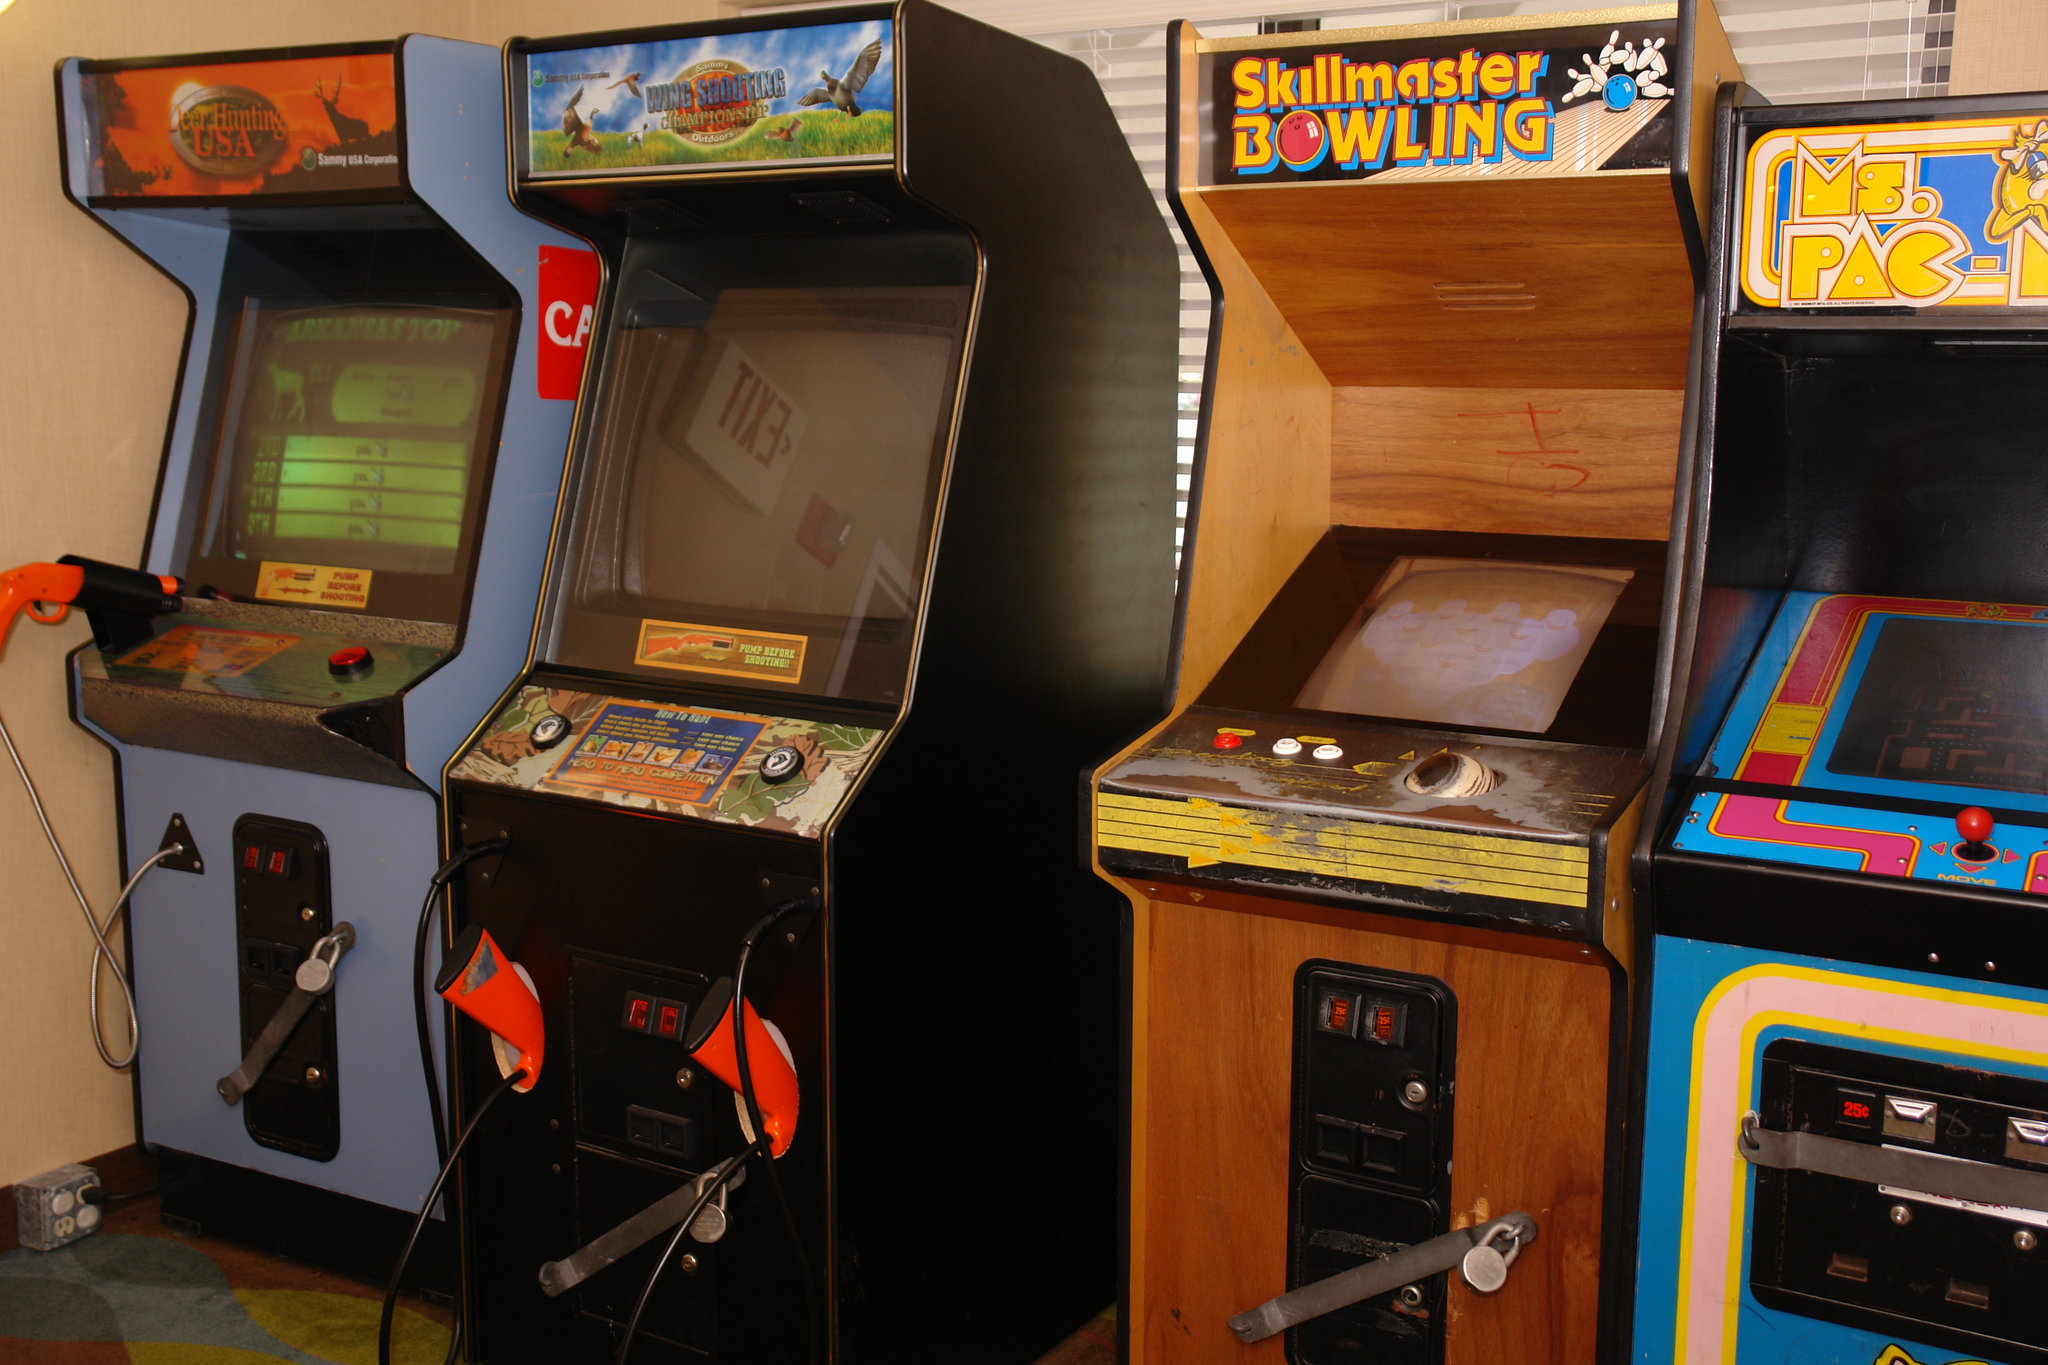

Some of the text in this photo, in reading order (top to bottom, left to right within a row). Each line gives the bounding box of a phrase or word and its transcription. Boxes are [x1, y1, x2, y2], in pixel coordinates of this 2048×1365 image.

[696, 60, 730, 73] Sammy
[1231, 48, 1549, 112] Skillmaster
[646, 68, 788, 114] WING SHOOTING
[168, 101, 288, 141] Deer Hunting
[660, 104, 771, 130] CHAMPIONSHIP
[192, 126, 257, 157] USA
[691, 130, 736, 145] Outdoors
[1231, 96, 1555, 174] BOWLING
[317, 152, 399, 168] Sammy USA Corporatio
[333, 571, 360, 581] PUMP
[327, 581, 362, 592] BEFORE
[320, 591, 365, 603] SHOOTING
[739, 643, 796, 659] PUMP BEFORE
[744, 654, 790, 669] SHOOTING!!
[567, 757, 597, 770] HEAD
[616, 763, 645, 776] HEAD
[649, 767, 719, 785] COMPETITION
[1936, 873, 1997, 887] MOVE
[1843, 1101, 1871, 1119] 25¢
